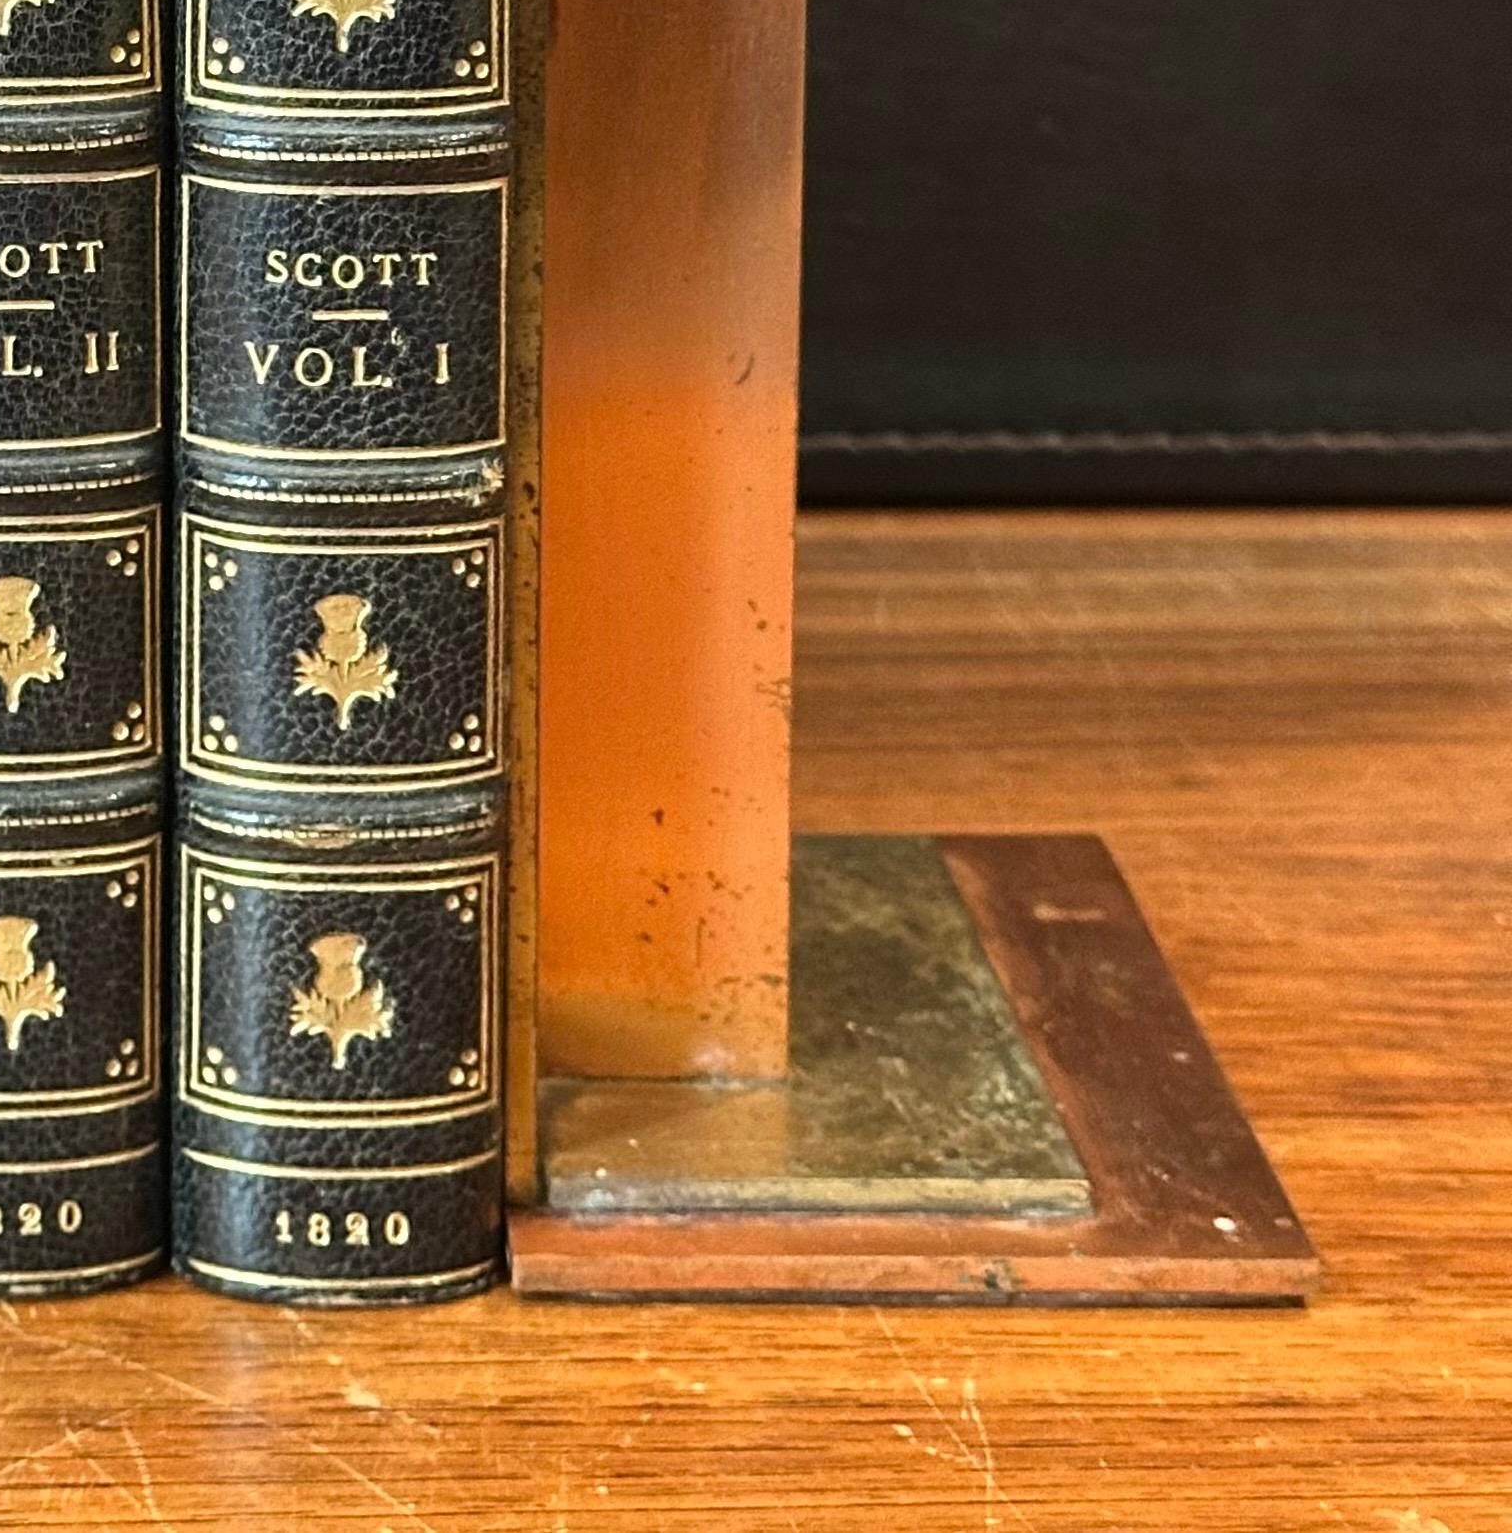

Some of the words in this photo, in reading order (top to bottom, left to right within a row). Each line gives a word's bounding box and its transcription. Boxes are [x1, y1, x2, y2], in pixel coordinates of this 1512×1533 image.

[264, 250, 438, 289] SCOTT
[84, 330, 120, 375] II
[243, 341, 393, 389] VOL.
[435, 343, 450, 384] I
[276, 1210, 410, 1247] 1820
